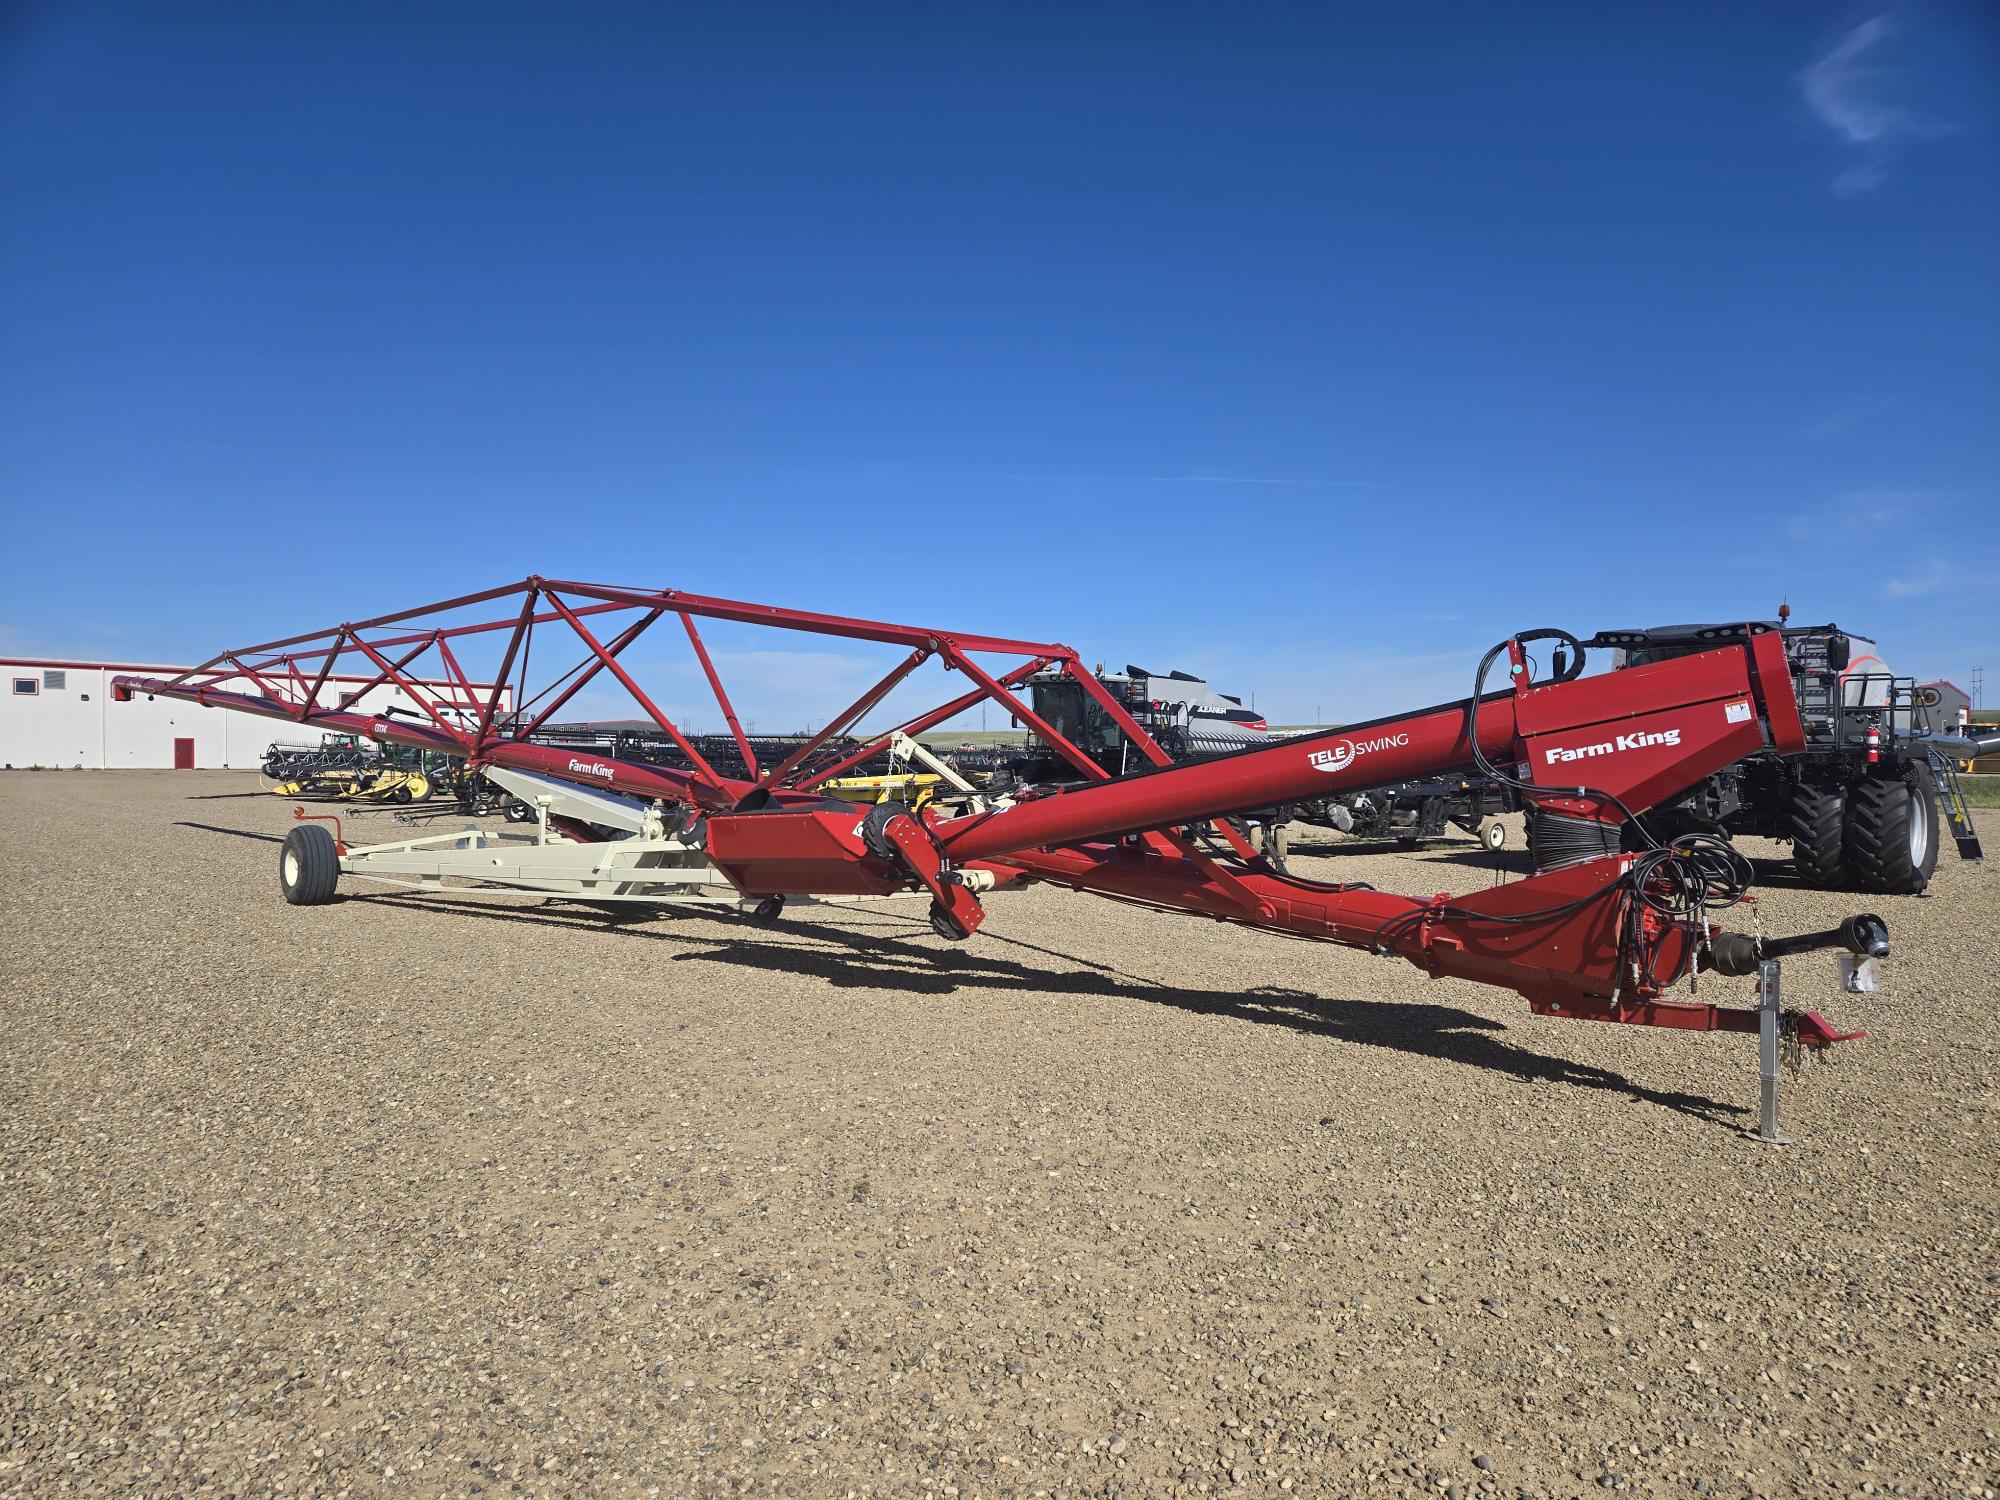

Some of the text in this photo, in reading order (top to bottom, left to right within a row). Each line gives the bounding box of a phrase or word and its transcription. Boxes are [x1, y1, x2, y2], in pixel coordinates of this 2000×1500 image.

[1307, 733, 1409, 765] TELE SWING
[1545, 728, 1681, 765] Farm King
[568, 758, 615, 781] Farm King
